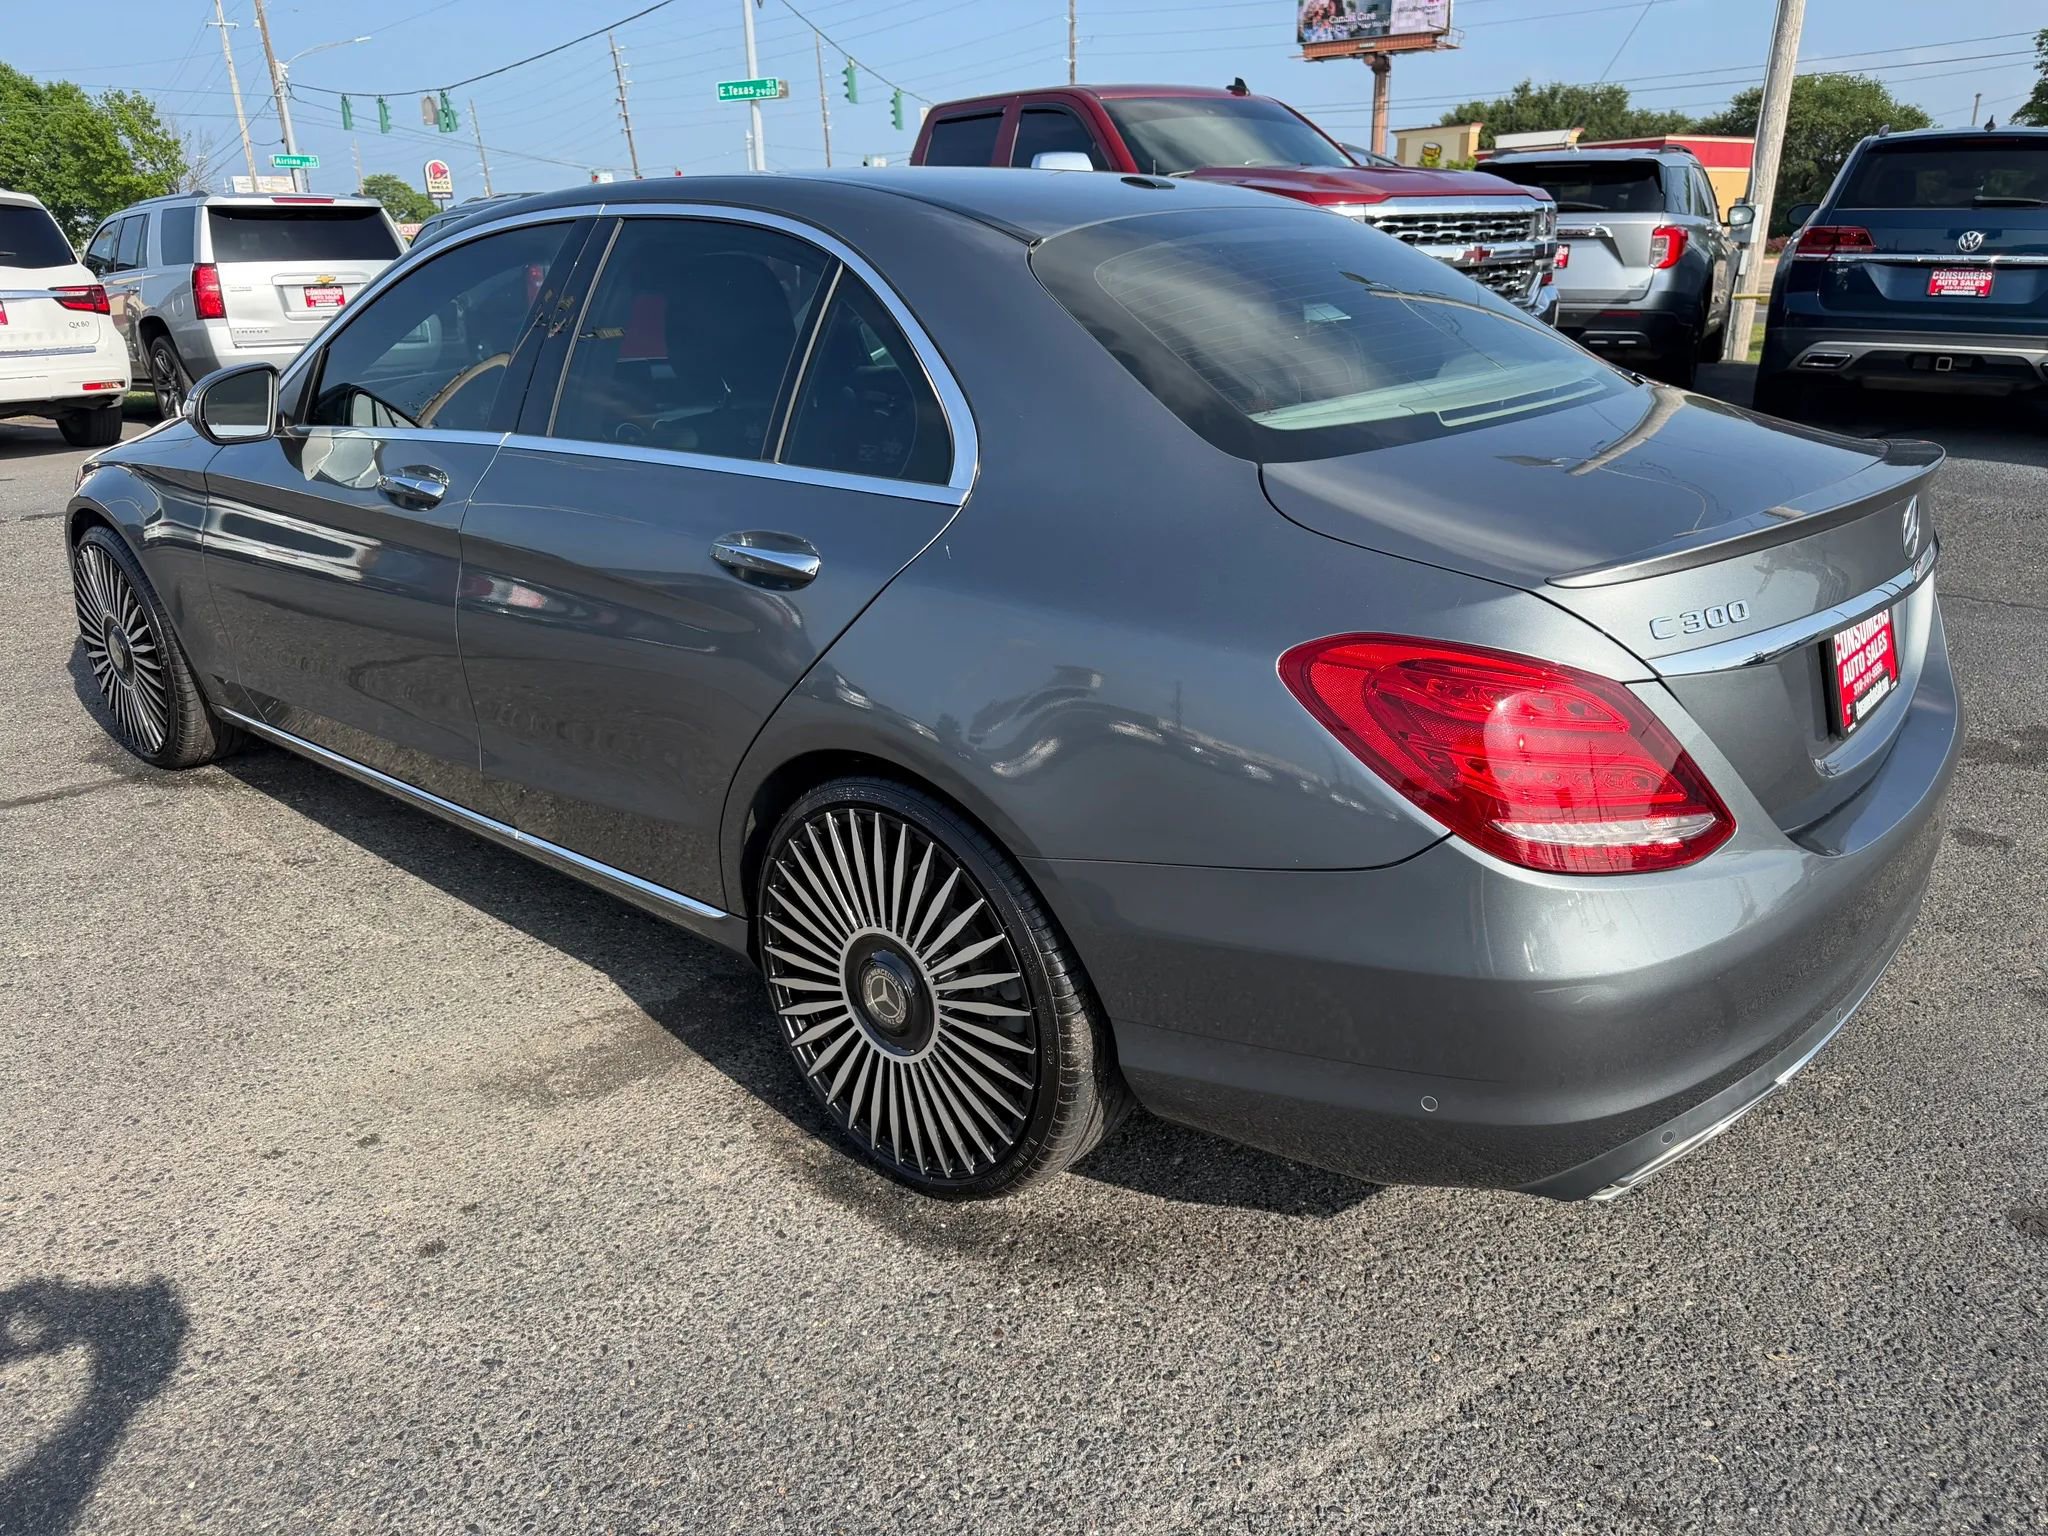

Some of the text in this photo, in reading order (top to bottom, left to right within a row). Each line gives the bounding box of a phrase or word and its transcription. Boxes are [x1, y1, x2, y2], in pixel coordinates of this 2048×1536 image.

[756, 88, 776, 97] 2900
[1932, 271, 1992, 280] CONSUMERS
[69, 320, 90, 329] QX80
[1649, 599, 1750, 640] C 300
[1834, 609, 1889, 666] CONSUMERS
[1842, 631, 1888, 689] AUTO SALES
